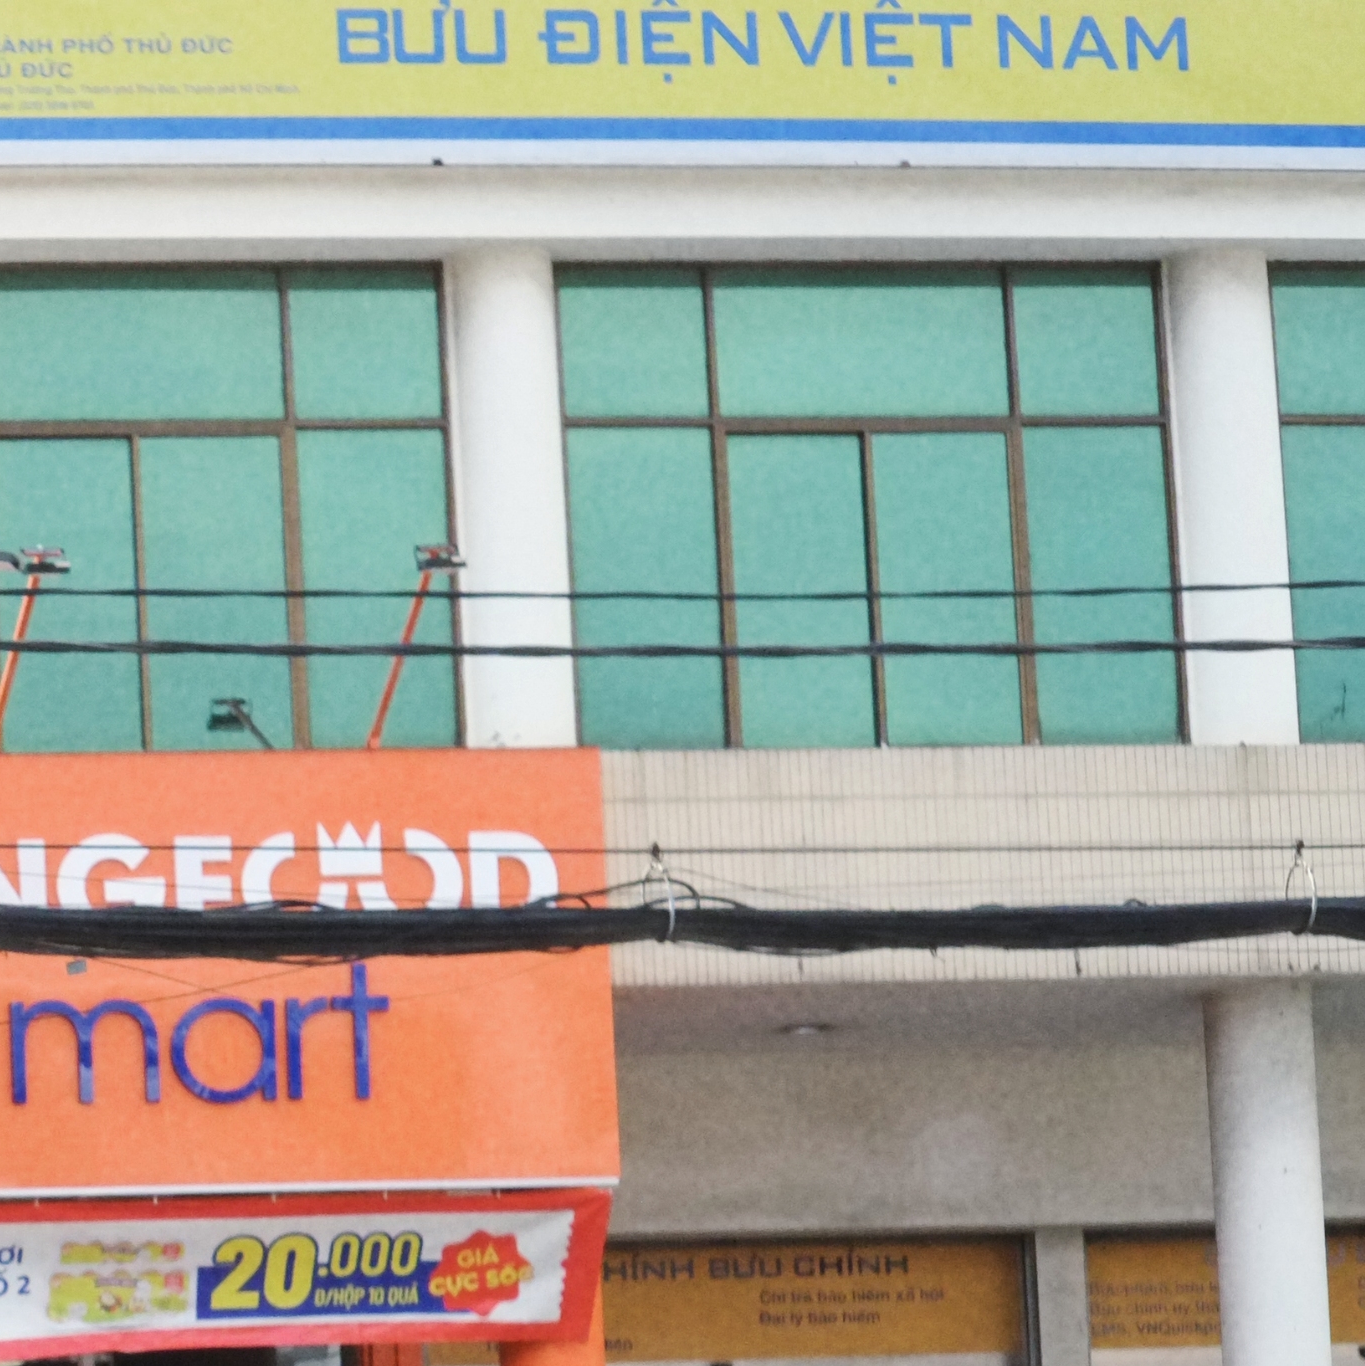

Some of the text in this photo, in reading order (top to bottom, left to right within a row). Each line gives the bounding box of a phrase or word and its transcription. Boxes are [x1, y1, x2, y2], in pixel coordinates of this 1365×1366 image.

[337, 0, 1191, 85] BƯU ĐIỆN VIỆT NAM
[10, 962, 390, 1105] mart
[15, 1275, 31, 1297] 2
[210, 1231, 423, 1310] 20.000
